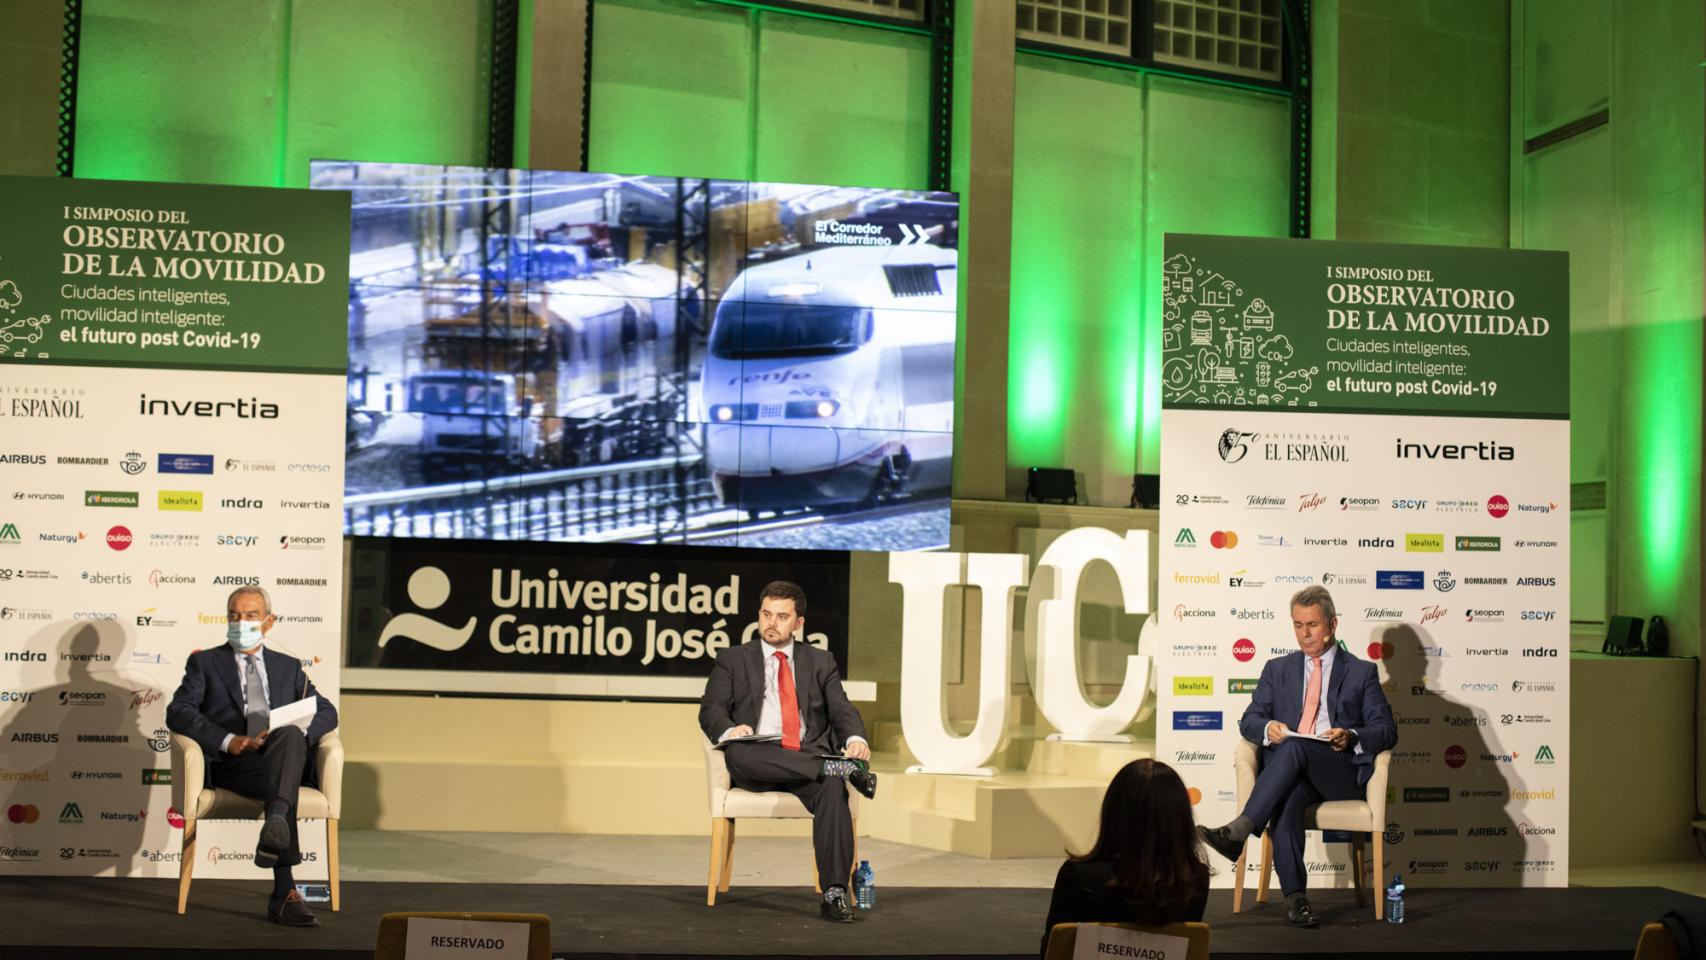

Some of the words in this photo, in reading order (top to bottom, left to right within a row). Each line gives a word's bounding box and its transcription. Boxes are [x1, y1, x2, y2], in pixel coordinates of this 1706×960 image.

[64, 207, 69, 219] I
[73, 207, 153, 223] SIMPOSIO
[158, 211, 189, 224] DEL
[815, 220, 828, 231] El
[830, 221, 883, 234] Corredor
[63, 225, 285, 255] OBSERVATORIO
[815, 232, 891, 245] Mediterráneo
[62, 253, 102, 275] DE
[109, 255, 146, 277] LA
[153, 258, 326, 284] MOVILIDAD
[1327, 267, 1332, 278] I
[1335, 267, 1403, 281] SIMPOSIO
[1407, 270, 1434, 282] DEL
[61, 284, 135, 301] Ciudades
[139, 287, 230, 306] inteligentes,
[1327, 284, 1515, 310] OBSERVATORIO
[61, 308, 137, 323] movilidad
[141, 311, 224, 327] inteligente:
[1327, 310, 1364, 330] DE
[1369, 312, 1401, 331] LA
[1404, 313, 1550, 337] MOVILIDAD
[60, 328, 76, 342] el
[81, 328, 136, 345] futuro
[141, 330, 179, 348] post
[183, 331, 260, 349] Covid-19
[1327, 338, 1390, 354] Ciudades
[1393, 341, 1470, 357] inteligentes,
[1327, 359, 1393, 374] movilidad
[1395, 361, 1467, 377] inteligente:
[0, 386, 86, 396] IVERSARIO
[1327, 379, 1342, 392] el
[1345, 379, 1392, 393] futuro
[1396, 381, 1428, 396] post
[1431, 380, 1497, 397] Covid-19
[12, 396, 84, 418] ESPAÑOL
[140, 393, 279, 419] invertia
[1265, 433, 1350, 441] ANIVERSARIO
[1265, 444, 1281, 460] EL
[1287, 442, 1349, 462] ESPAÑOL
[1397, 438, 1514, 461] invertia
[0, 454, 46, 464] AIRBUS
[57, 457, 109, 465] BOMBARDIER
[221, 498, 263, 508] indra
[281, 500, 330, 509] invertia
[1299, 493, 1327, 512] Talgo
[1349, 498, 1380, 507] seopan
[1518, 504, 1549, 513] Naturgy
[40, 533, 77, 543] Naturgy
[290, 536, 325, 544] seopan
[1304, 537, 1347, 546] invertia
[1358, 538, 1394, 548] indra
[89, 572, 132, 584] abertis
[159, 574, 195, 584] acciona
[213, 576, 260, 585] AIRBUS
[276, 578, 327, 586] BOMBARDIER
[1174, 572, 1220, 584] ferrovial
[1230, 578, 1243, 587] EY
[1464, 577, 1507, 585] BOMBARDIER
[1516, 577, 1556, 586] AIRBUS
[491, 568, 740, 616] Universidad
[198, 612, 228, 624] ferro
[1237, 609, 1274, 619] abertis
[1420, 605, 1447, 624] Talgo
[137, 617, 152, 625] EY
[488, 615, 622, 656] Camilo
[640, 617, 730, 666] José
[1233, 645, 1255, 654] ouigo
[1466, 648, 1508, 656] invertia
[1523, 647, 1557, 657] indra
[5, 651, 46, 661] indra
[61, 652, 111, 661] invertia
[69, 692, 105, 700] seopan
[1412, 687, 1424, 695] EY
[0, 692, 35, 703] acyr
[1399, 716, 1429, 724] acciona
[1451, 715, 1486, 726] abertis
[11, 733, 59, 743] AIRBUS
[77, 735, 129, 743] BOMBARDIER
[1481, 753, 1512, 762] Naturgy
[0, 770, 48, 781] errovial
[1512, 789, 1555, 799] ferrovial
[101, 812, 139, 821] Naturgy
[1468, 827, 1507, 836] AIRBUS
[150, 850, 183, 862] abert
[218, 851, 254, 860] acciona
[431, 936, 504, 950] RESERVADO
[1098, 942, 1165, 960] RESERVADO
